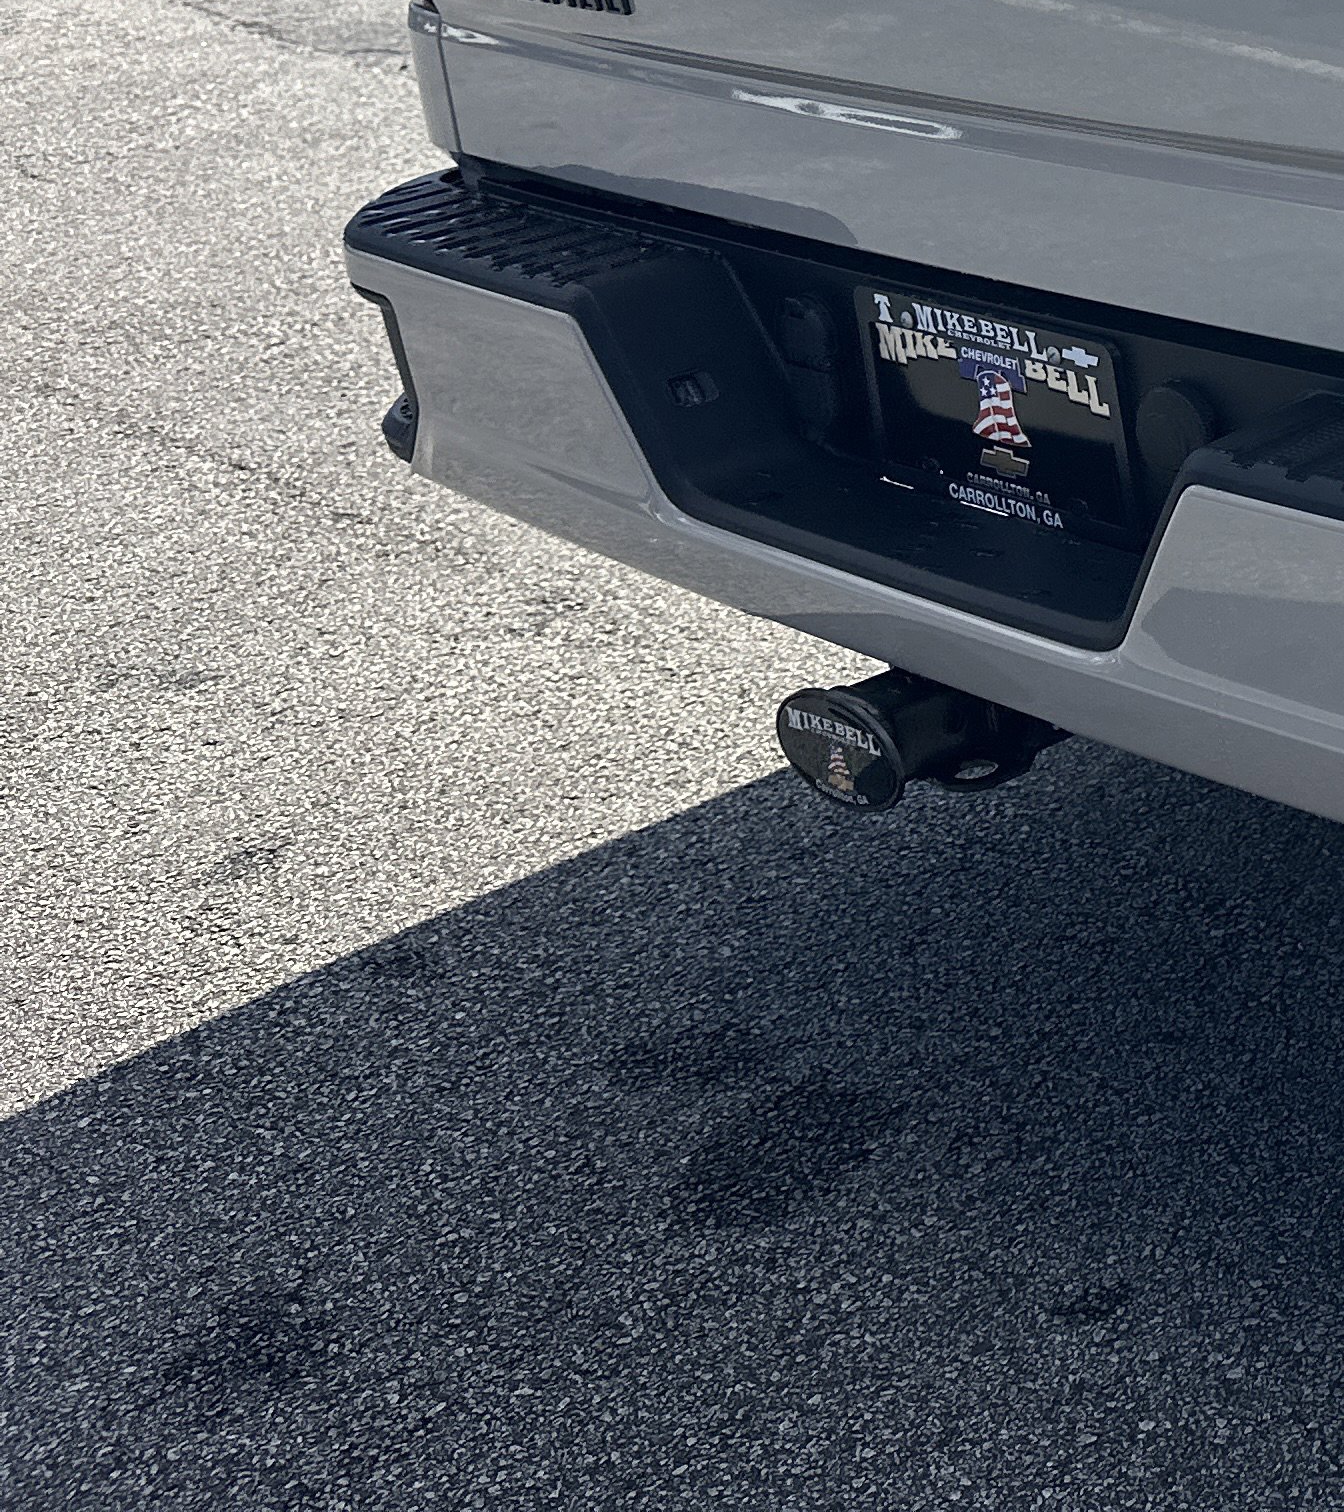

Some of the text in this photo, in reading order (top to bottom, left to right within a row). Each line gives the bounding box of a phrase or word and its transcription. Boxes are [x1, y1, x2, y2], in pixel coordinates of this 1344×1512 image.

[911, 302, 1048, 361] MIKE BELL
[946, 329, 1011, 350] CHEVROLET
[875, 322, 1110, 418] MIKE BELL
[960, 346, 1018, 371] CHEVROLET
[949, 483, 1063, 528] CARROLLTON, GA
[785, 706, 833, 731] MIKE
[834, 721, 881, 757] BELL
